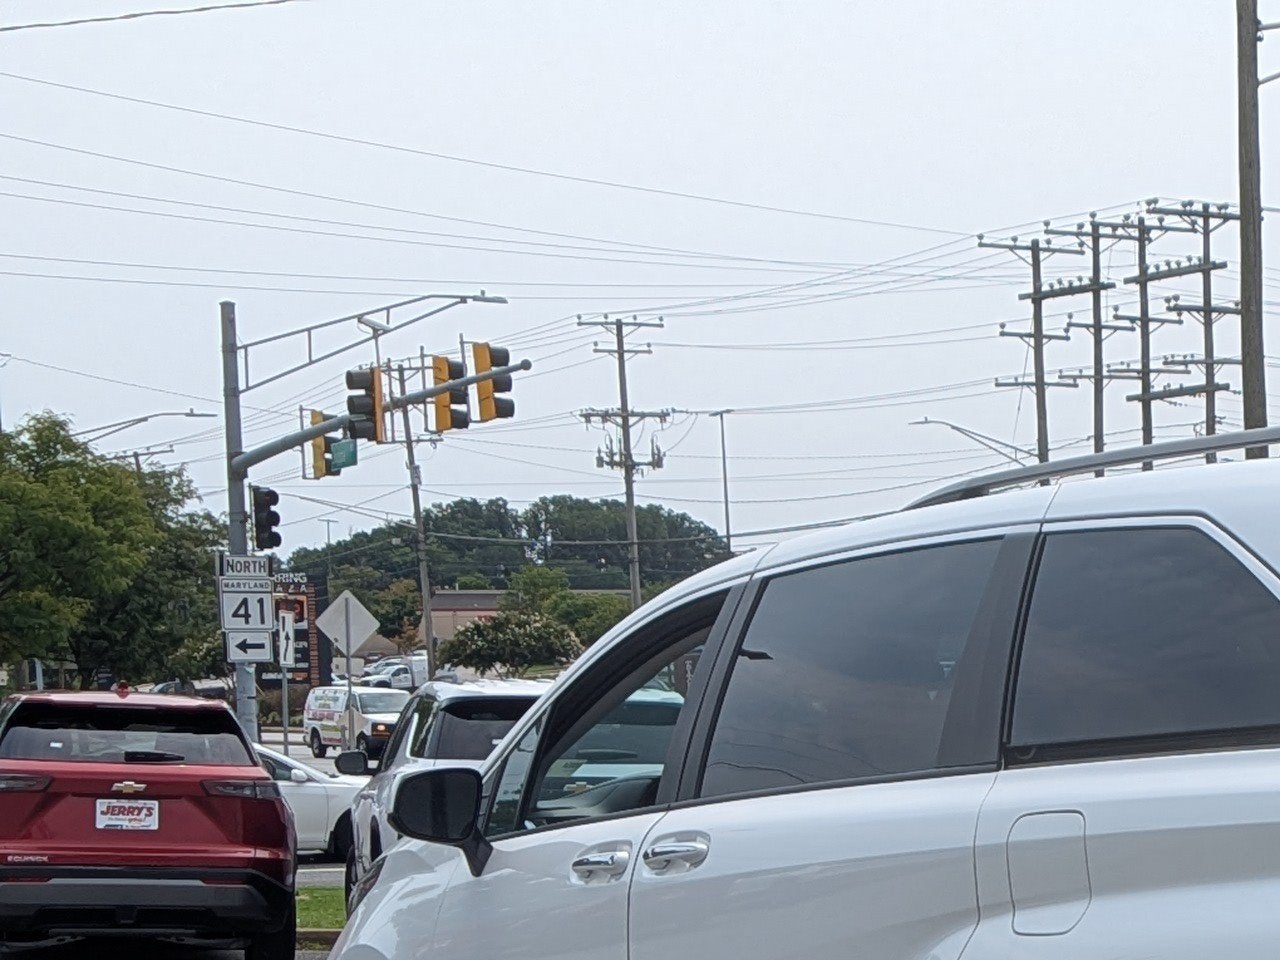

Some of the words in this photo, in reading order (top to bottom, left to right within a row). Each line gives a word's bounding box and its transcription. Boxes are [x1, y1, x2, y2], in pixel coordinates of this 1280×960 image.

[226, 558, 267, 574] NORTH
[223, 581, 270, 590] MARYLAND
[231, 597, 266, 625] 41
[100, 805, 155, 817] JERRY'S
